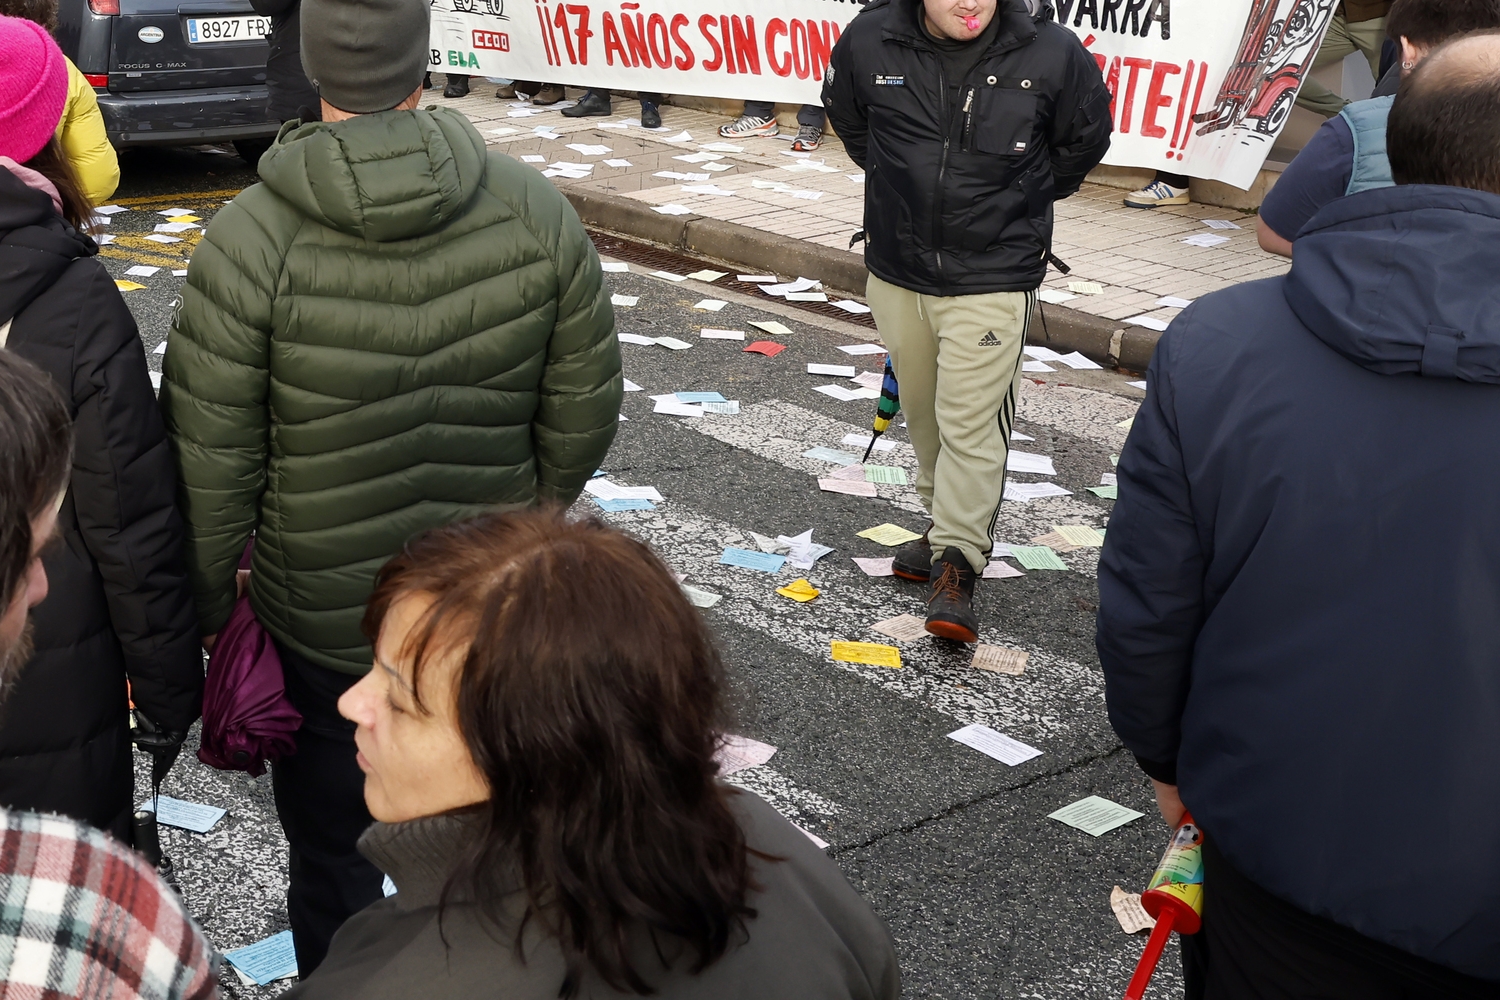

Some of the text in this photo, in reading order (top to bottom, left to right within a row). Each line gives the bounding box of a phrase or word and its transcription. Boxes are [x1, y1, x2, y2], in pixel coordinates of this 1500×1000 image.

[202, 20, 240, 39] 8927
[247, 18, 272, 36] FBX
[603, 2, 695, 71] AÑOS
[701, 14, 761, 75] SIN
[474, 32, 508, 50] CCOO
[448, 50, 481, 69] ELA
